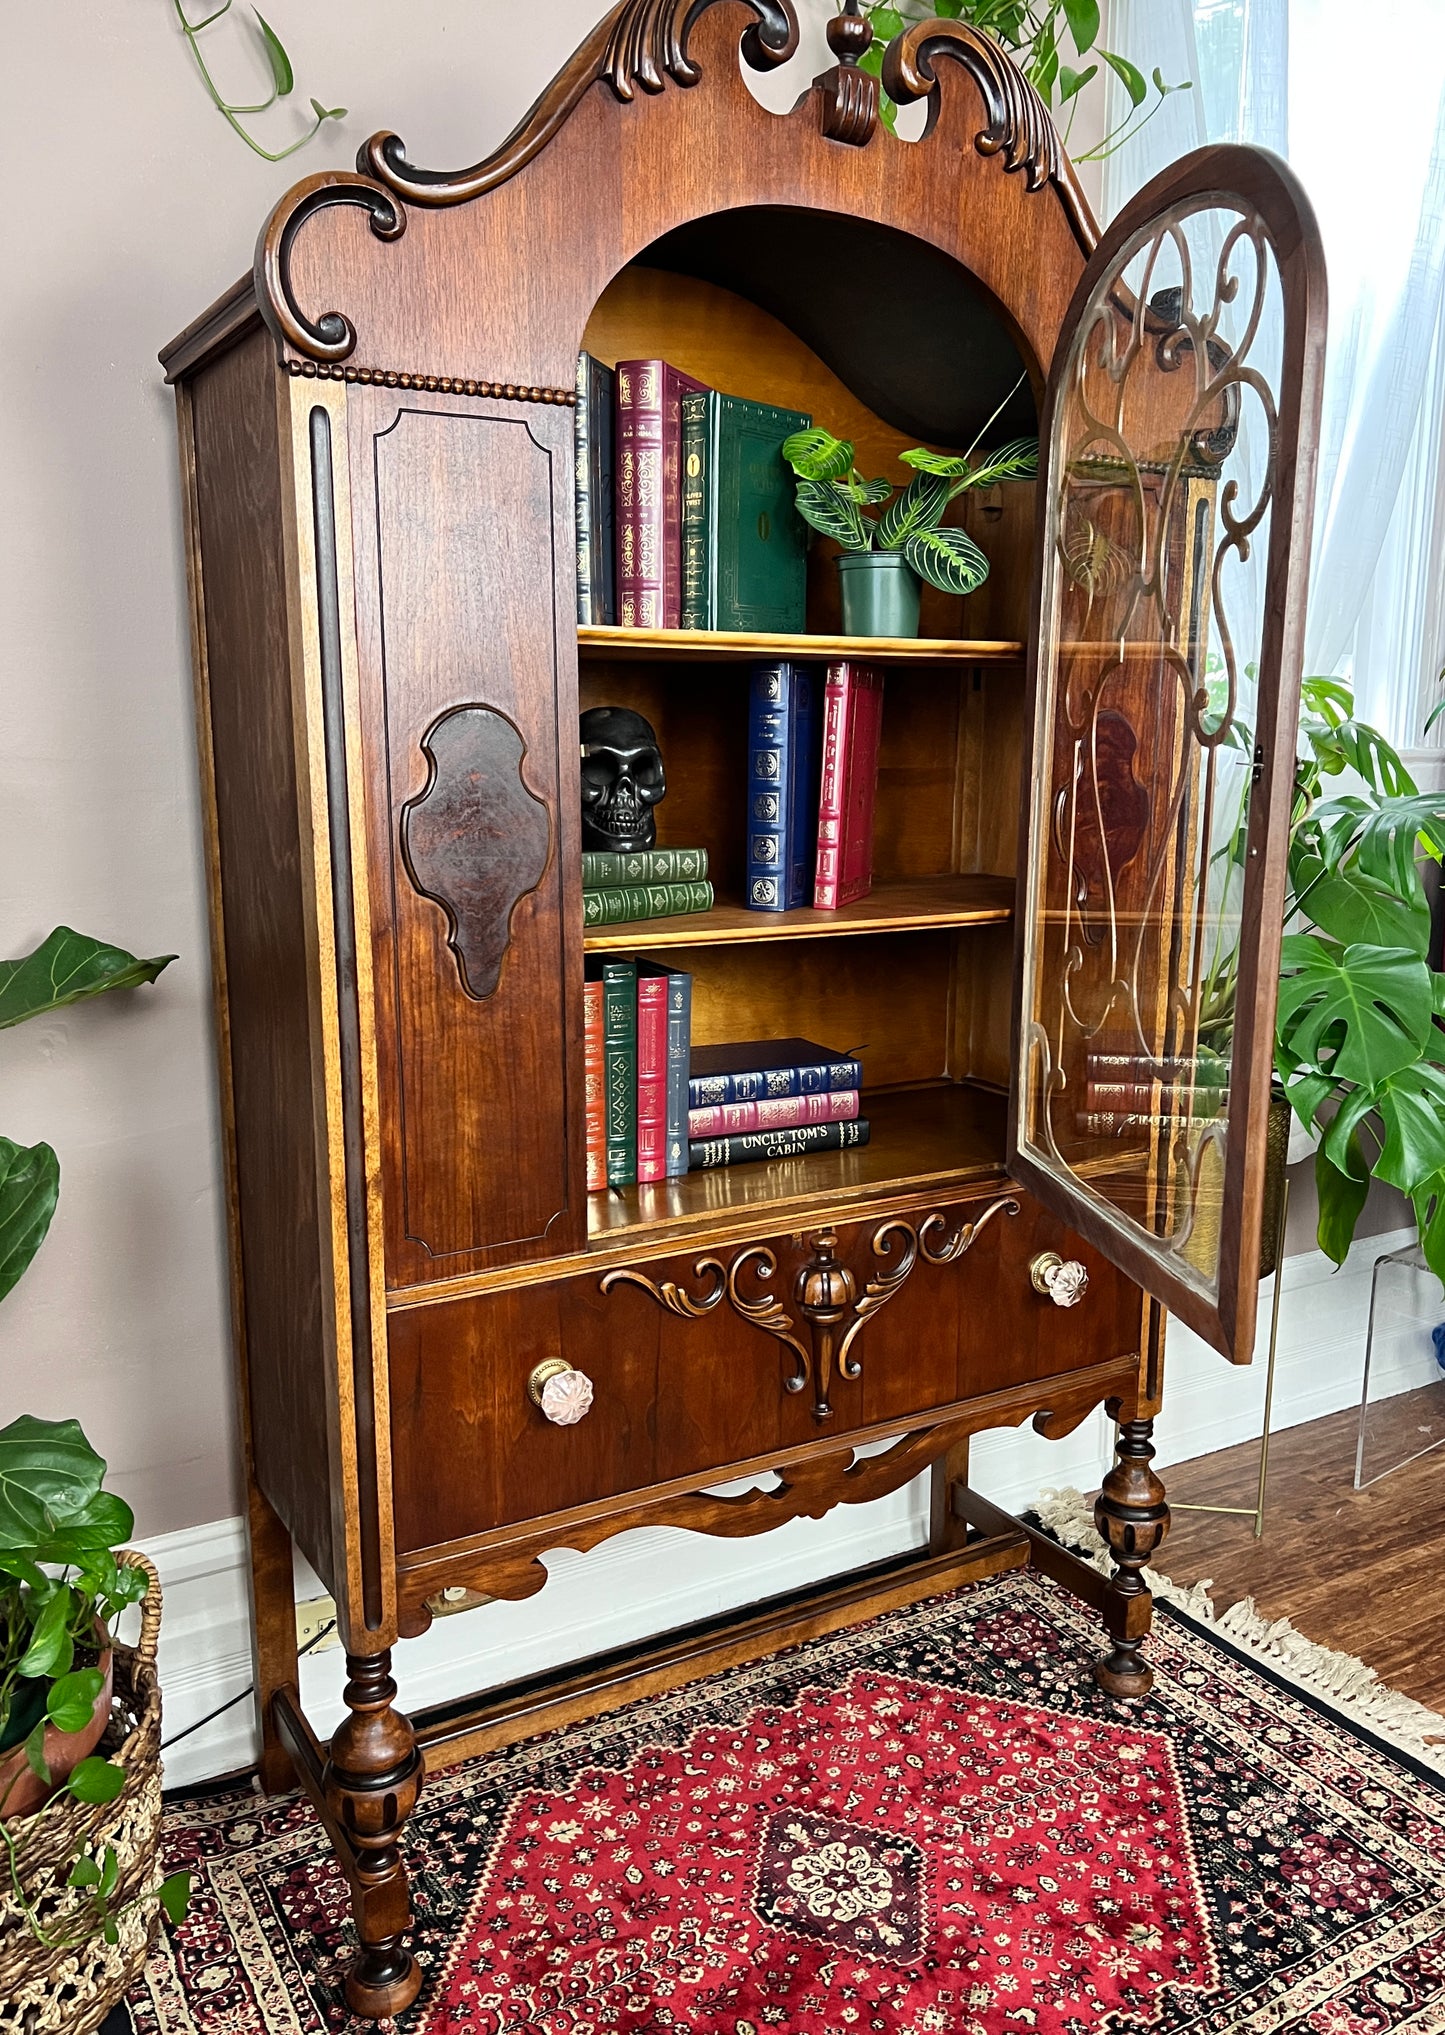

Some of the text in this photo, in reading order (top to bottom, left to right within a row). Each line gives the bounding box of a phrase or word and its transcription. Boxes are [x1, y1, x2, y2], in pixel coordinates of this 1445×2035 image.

[741, 1125, 828, 1149] UNCLE TOM'S
[767, 1141, 806, 1157] CABIN
